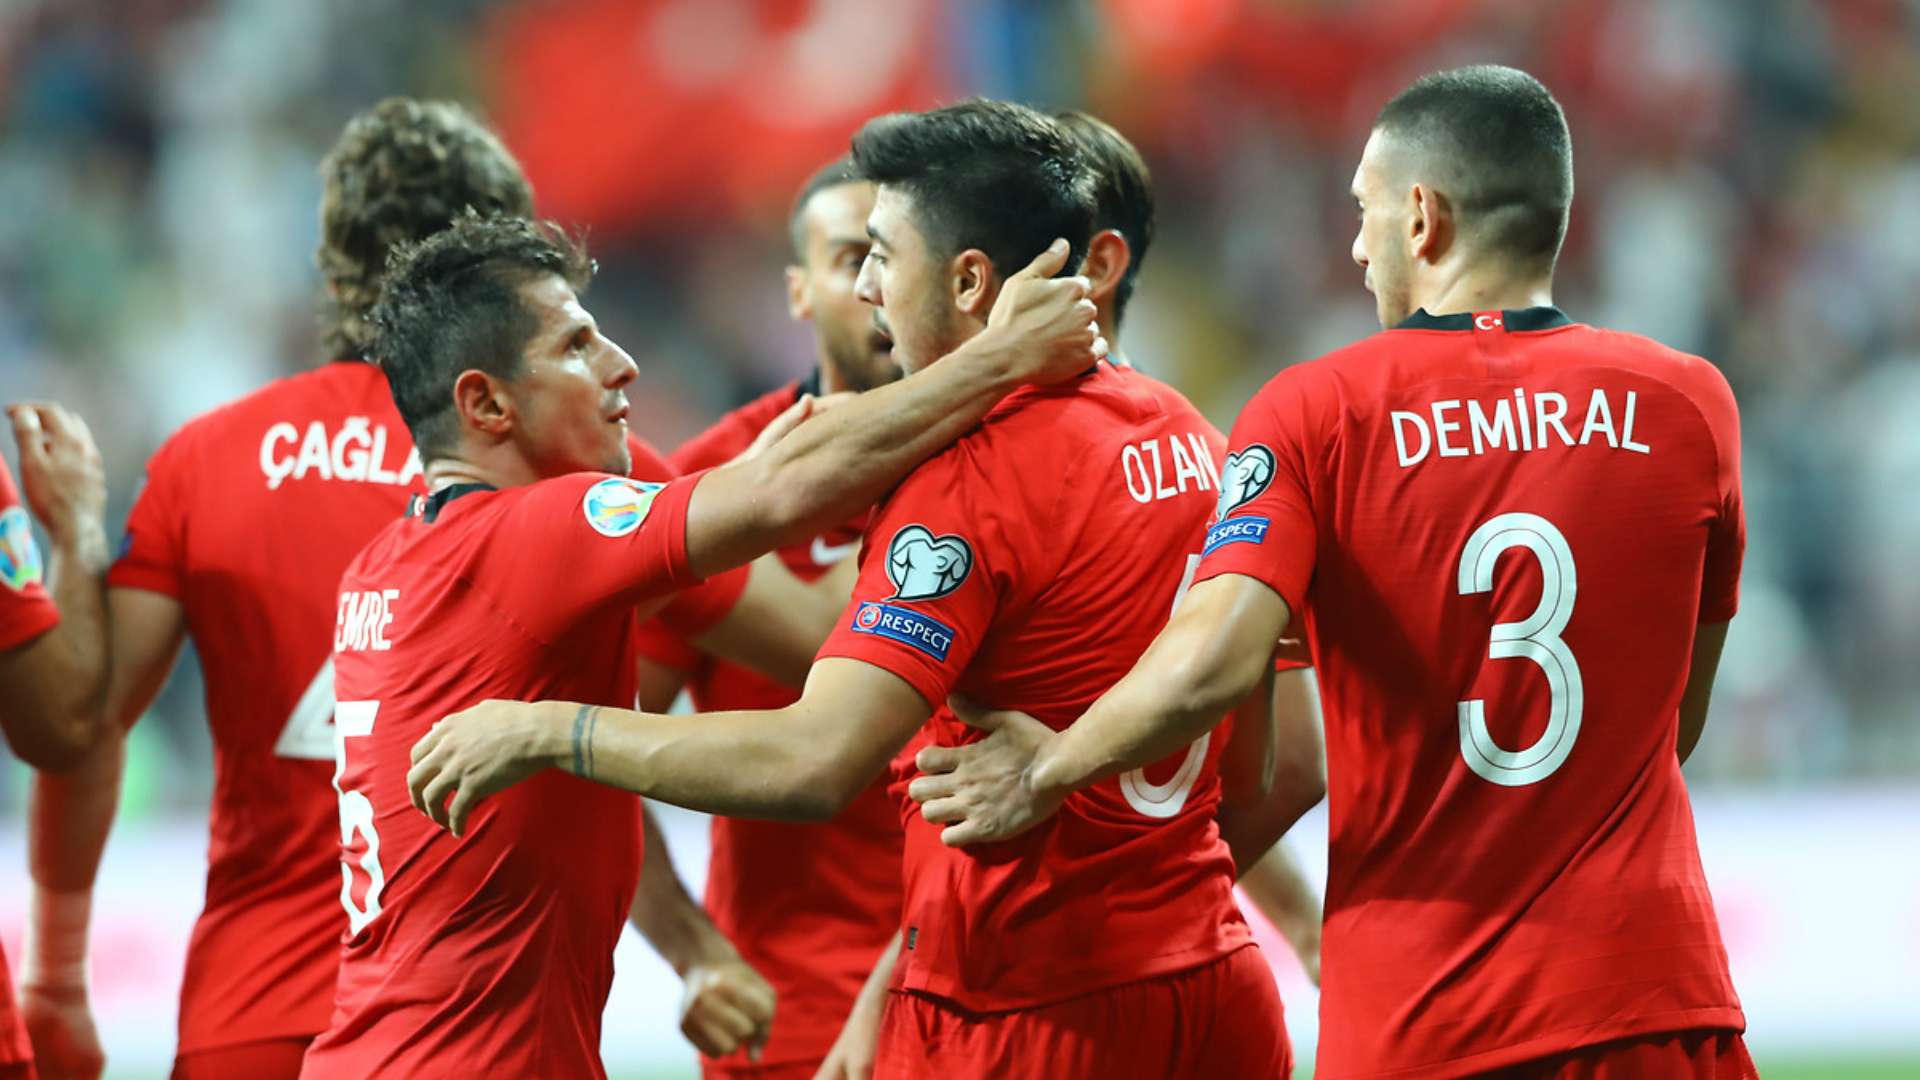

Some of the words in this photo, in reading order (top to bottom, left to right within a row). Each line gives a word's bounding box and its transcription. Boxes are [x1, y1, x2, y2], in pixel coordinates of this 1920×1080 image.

[1390, 387, 1651, 468] DEMİRAL
[1122, 432, 1222, 504] OZAN
[334, 588, 400, 653] EMRE
[881, 612, 951, 651] RESPECT
[1457, 512, 1584, 787] 3
